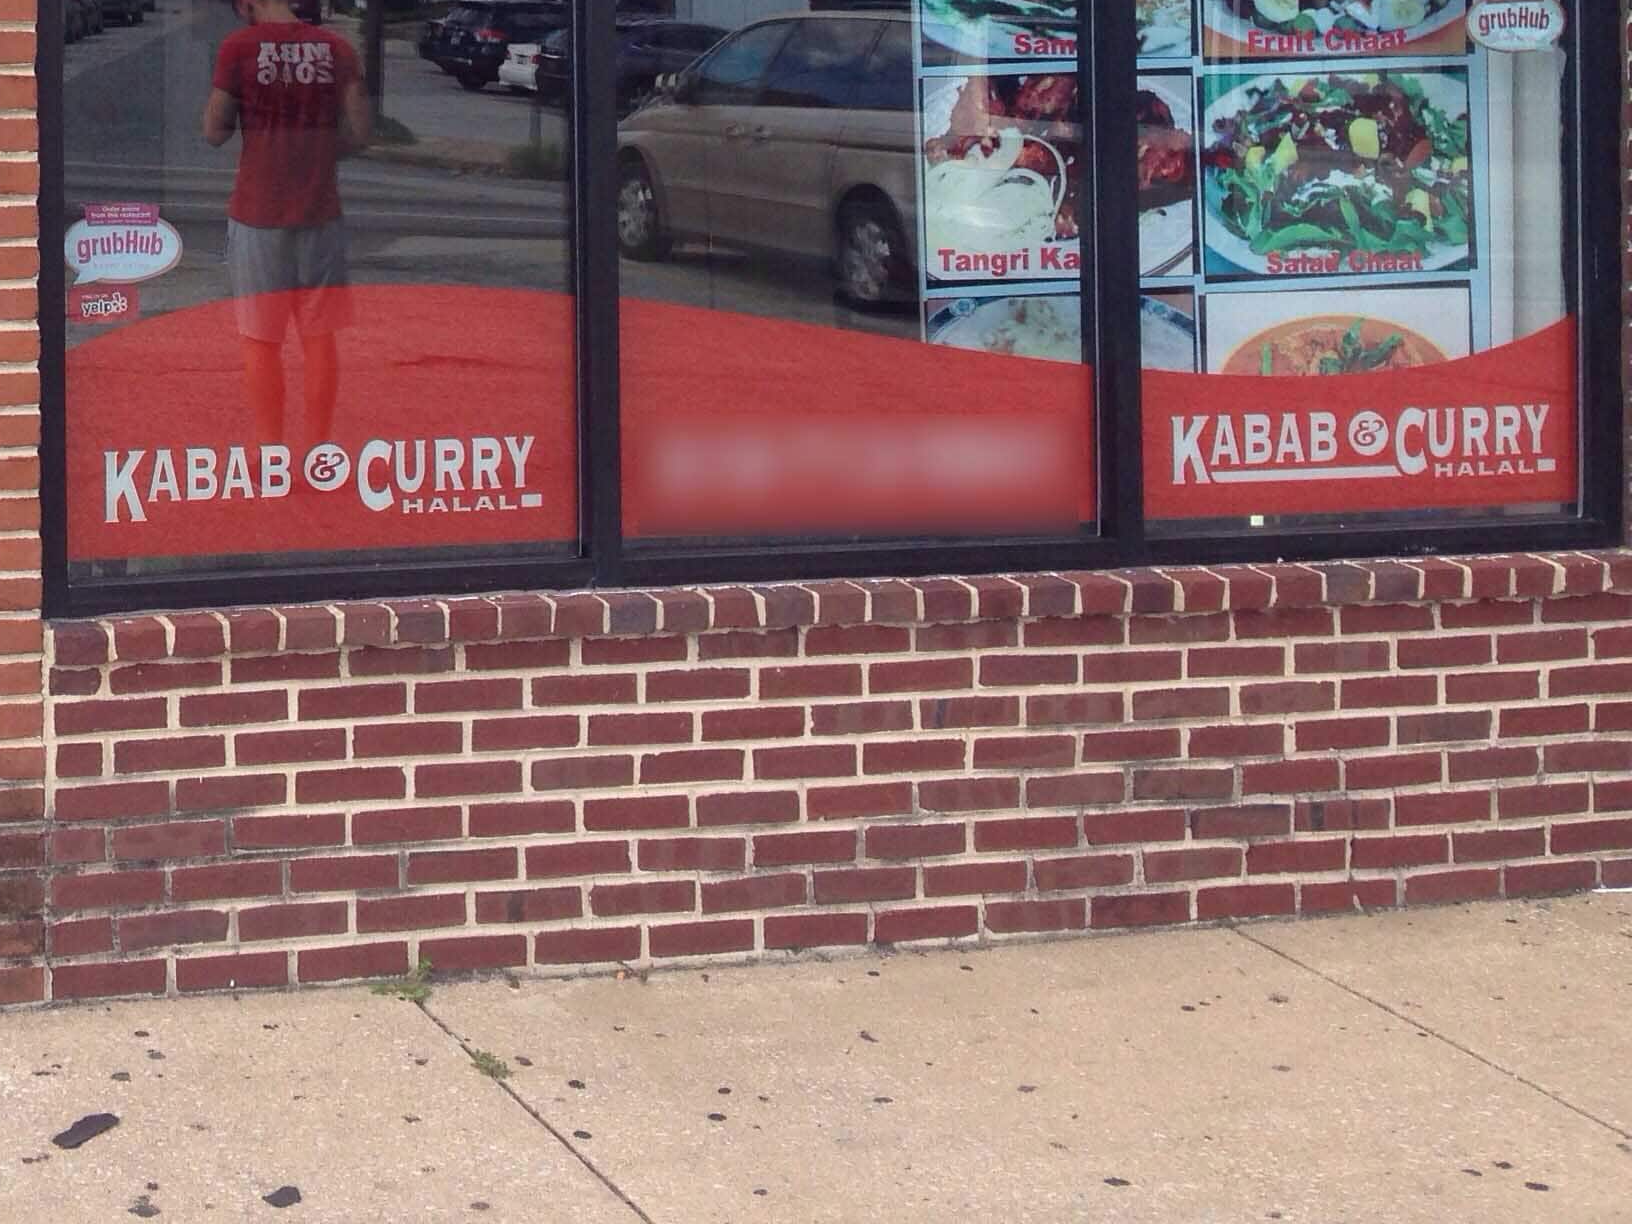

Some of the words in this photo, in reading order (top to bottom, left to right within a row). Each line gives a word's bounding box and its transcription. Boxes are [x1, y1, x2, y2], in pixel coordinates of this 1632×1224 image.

[1478, 6, 1550, 36] grubHub
[1014, 33, 1077, 56] Sam
[1247, 29, 1316, 54] Fruit
[1324, 27, 1409, 51] Chaat
[77, 229, 163, 264] grubHub
[938, 248, 1029, 277] Tangri
[1040, 247, 1080, 271] Ka
[1266, 249, 1341, 274] Salad
[1347, 248, 1424, 272] Chaat
[81, 299, 114, 317] yelp
[1171, 412, 1337, 486] KABAB
[1395, 404, 1551, 476] CURRY
[104, 445, 292, 524] KABAB
[357, 435, 535, 512] CURRY
[1434, 458, 1535, 478] HALAL
[402, 495, 518, 514] HALAL
